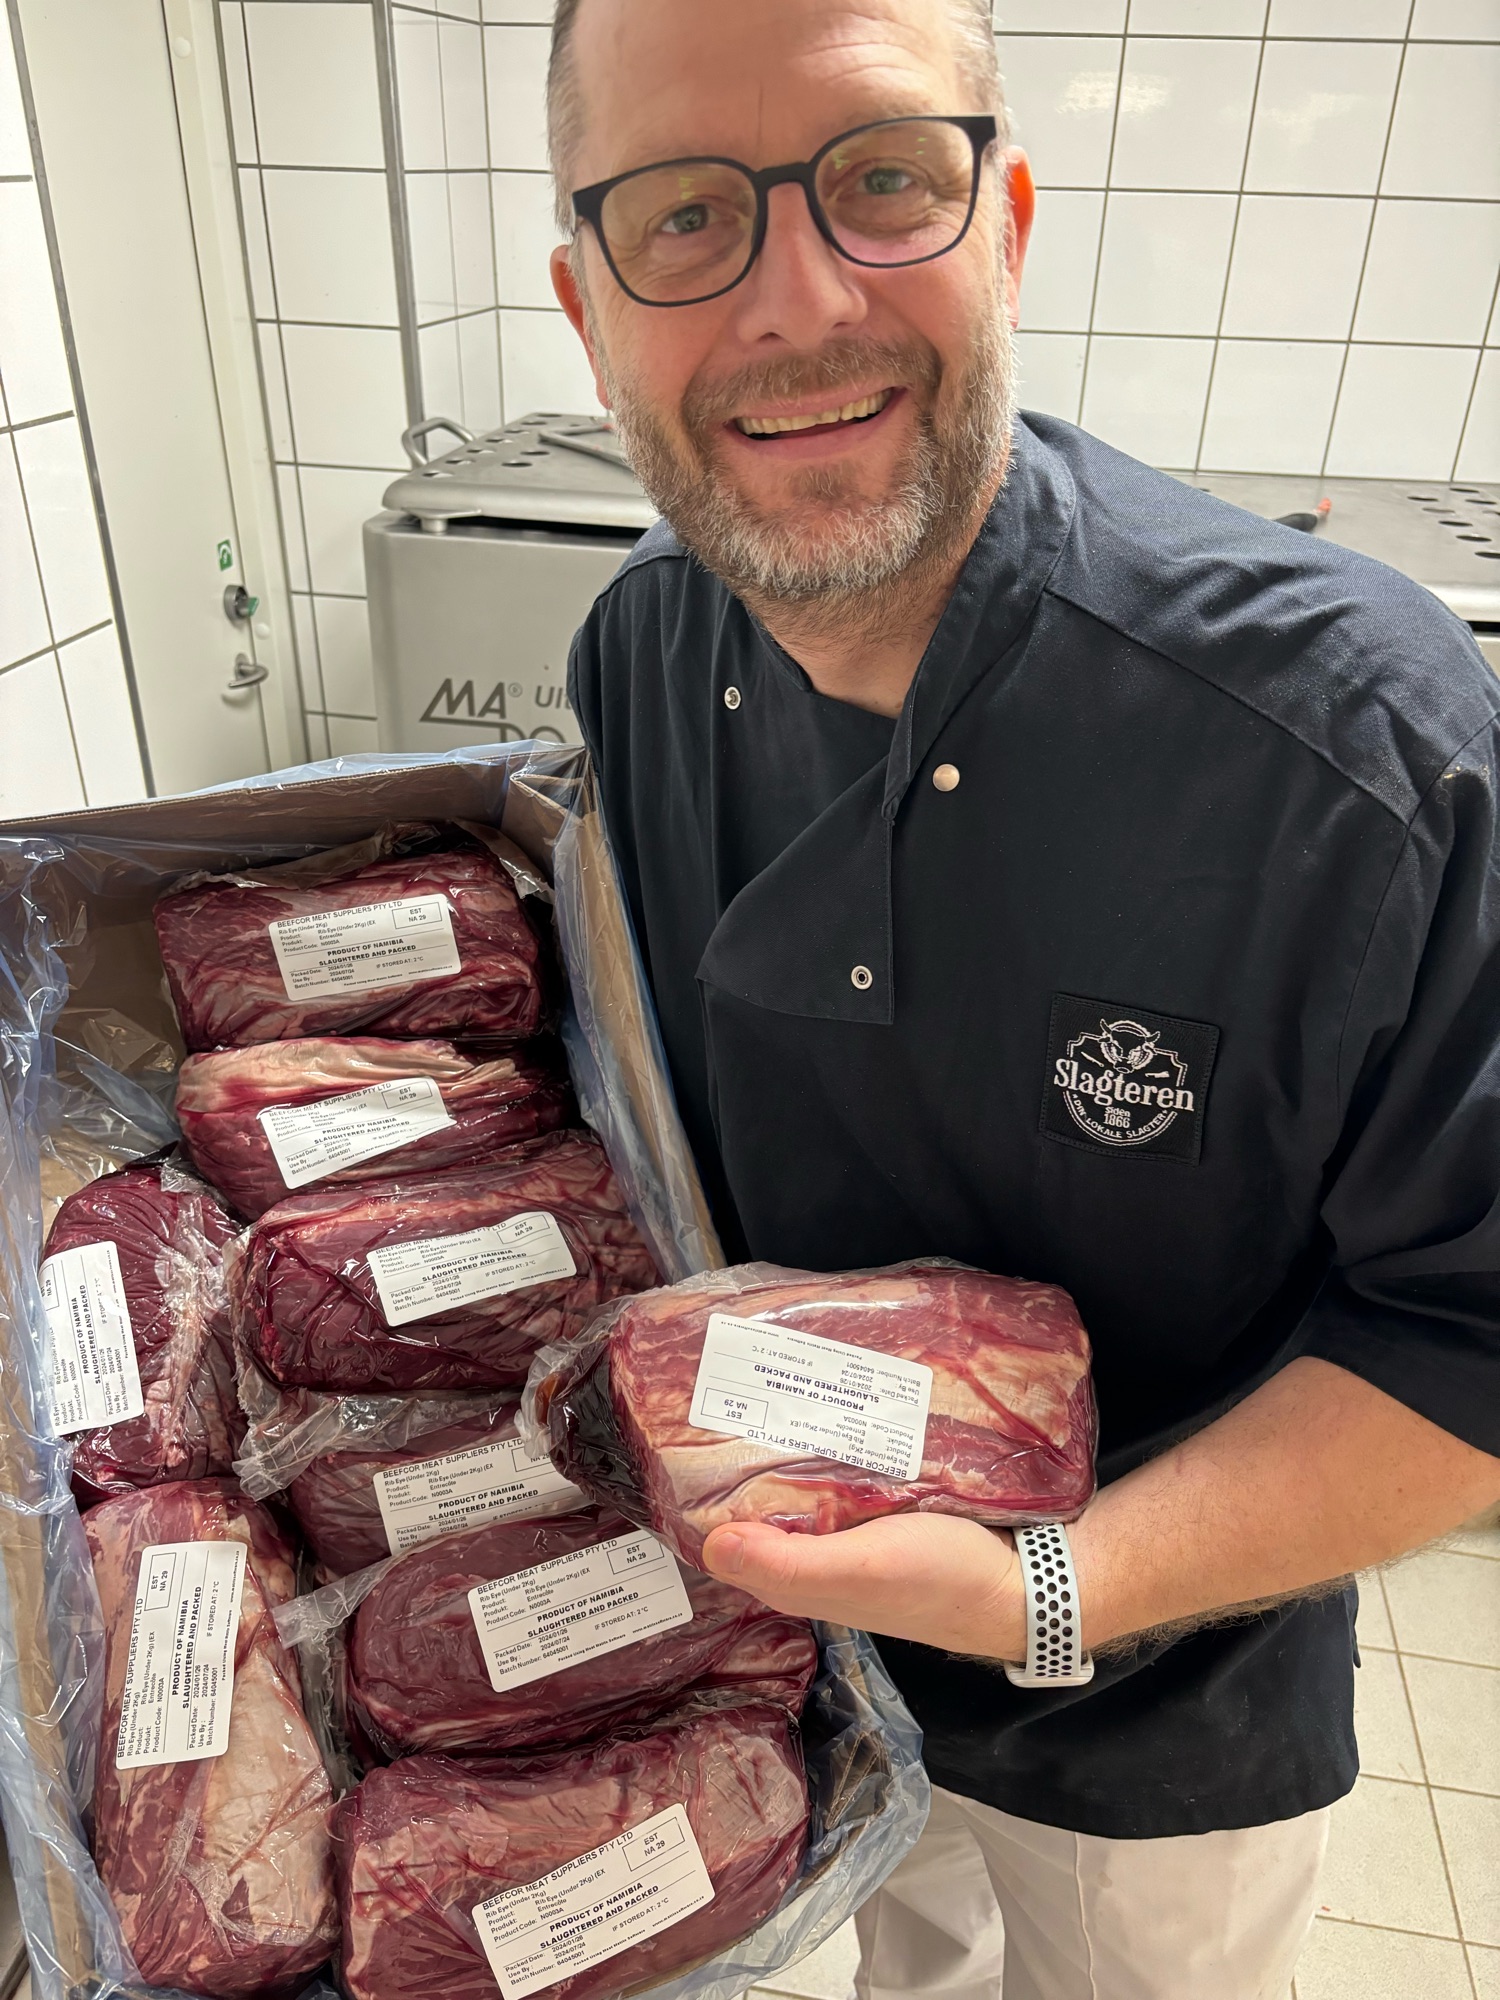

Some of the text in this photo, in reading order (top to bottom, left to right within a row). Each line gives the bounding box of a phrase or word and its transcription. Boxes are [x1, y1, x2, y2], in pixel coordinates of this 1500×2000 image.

[276, 916, 311, 928] BEEFCOR
[311, 913, 331, 921] MEAT
[332, 906, 371, 917] SUPPLIERS
[388, 900, 402, 908] LTD
[318, 944, 416, 966] SLAUGHTERED AND PACKED
[326, 946, 360, 956] PRODUCT
[373, 938, 403, 948] NAMIBIA
[398, 1086, 412, 1094] EST
[1053, 1058, 1195, 1112] Slagteren
[303, 1102, 322, 1111] MEAT
[323, 1091, 361, 1106] SUPPLIERS
[1105, 1106, 1131, 1117] siden
[322, 1125, 355, 1134] PRODUCT
[367, 1117, 397, 1126] NAMIBIA
[1074, 1099, 1167, 1139] DIN LOKALE SLAGTER
[1103, 1113, 1131, 1129] 1866
[313, 1129, 365, 1144] SLAUGHTERED
[491, 1222, 506, 1231] LTD
[514, 1221, 527, 1230] EST
[422, 1252, 527, 1281] SLAUGHTERED AND PACKED
[431, 1258, 467, 1271] PRODUCT
[480, 1249, 512, 1258] NAMIBIA
[46, 1287, 52, 1296] NA
[71, 1297, 90, 1374] PRODUCT OF NAMIBIA
[79, 1284, 101, 1384] SLAUGHTERED AND PACKED
[753, 1363, 879, 1403] SLAUGHTERED AND PACKED
[846, 1361, 920, 1386] Batch Number: 64045001
[723, 1398, 747, 1410] NA 29
[765, 1378, 864, 1411] PRODUCT OF NAMIBIA
[726, 1408, 742, 1419] EST
[382, 1438, 523, 1479] BEEFCOR MEAT SUPPLIERS PTY LTD
[746, 1428, 907, 1477] BEEFCOR MEAT SUPPLIERS PTY LTD
[848, 1443, 909, 1466] Rib Eye (Under 2Kg)
[428, 1502, 486, 1521] SLAUGHTERED
[487, 1497, 505, 1507] AND
[505, 1488, 539, 1503] PACKED
[437, 1495, 476, 1509] PRODUCT
[489, 1482, 524, 1497] NAMIBIA
[626, 1544, 640, 1554] EST
[626, 1551, 646, 1564] NA 29
[159, 1570, 168, 1590] NA 29
[476, 1539, 617, 1594] BEEFCOR MEAT SUPPLIERS PTY LTD
[151, 1574, 159, 1589] EST
[527, 1591, 639, 1638] SLAUGHTERED AND PACKED
[536, 1585, 624, 1622] PRODUCT OF NAMIBIA
[171, 1599, 189, 1695] PRODUCT OF NAMIBIA
[181, 1586, 202, 1708] SLAUGHTERED AND PACKED
[494, 1646, 516, 1659] Packed
[516, 1640, 532, 1651] Date:
[117, 1598, 143, 1757] BEEFCOR MEAT SUPPLIERS PTY LTD
[151, 1677, 165, 1752] Product Code: N0003A
[188, 1664, 201, 1748] Packed Date: 2024/01/26
[205, 1666, 218, 1745] Batch Number: 64045001
[126, 1691, 141, 1755] Rib Eye (Under 2Kg)
[142, 1725, 152, 1753] Produkt:
[643, 1832, 659, 1845] EST
[643, 1839, 665, 1856] NA 29
[482, 1830, 634, 1911] BEEFCOR MEAT SUPPLIERS PTY LTD
[539, 1914, 603, 1949] SLAUGHTERED
[604, 1903, 623, 1918] AND
[624, 1884, 659, 1908] PACKED
[549, 1881, 643, 1932] PRODUCT OF NAMIBIA
[493, 1926, 519, 1943] Product
[518, 1916, 537, 1931] Code:
